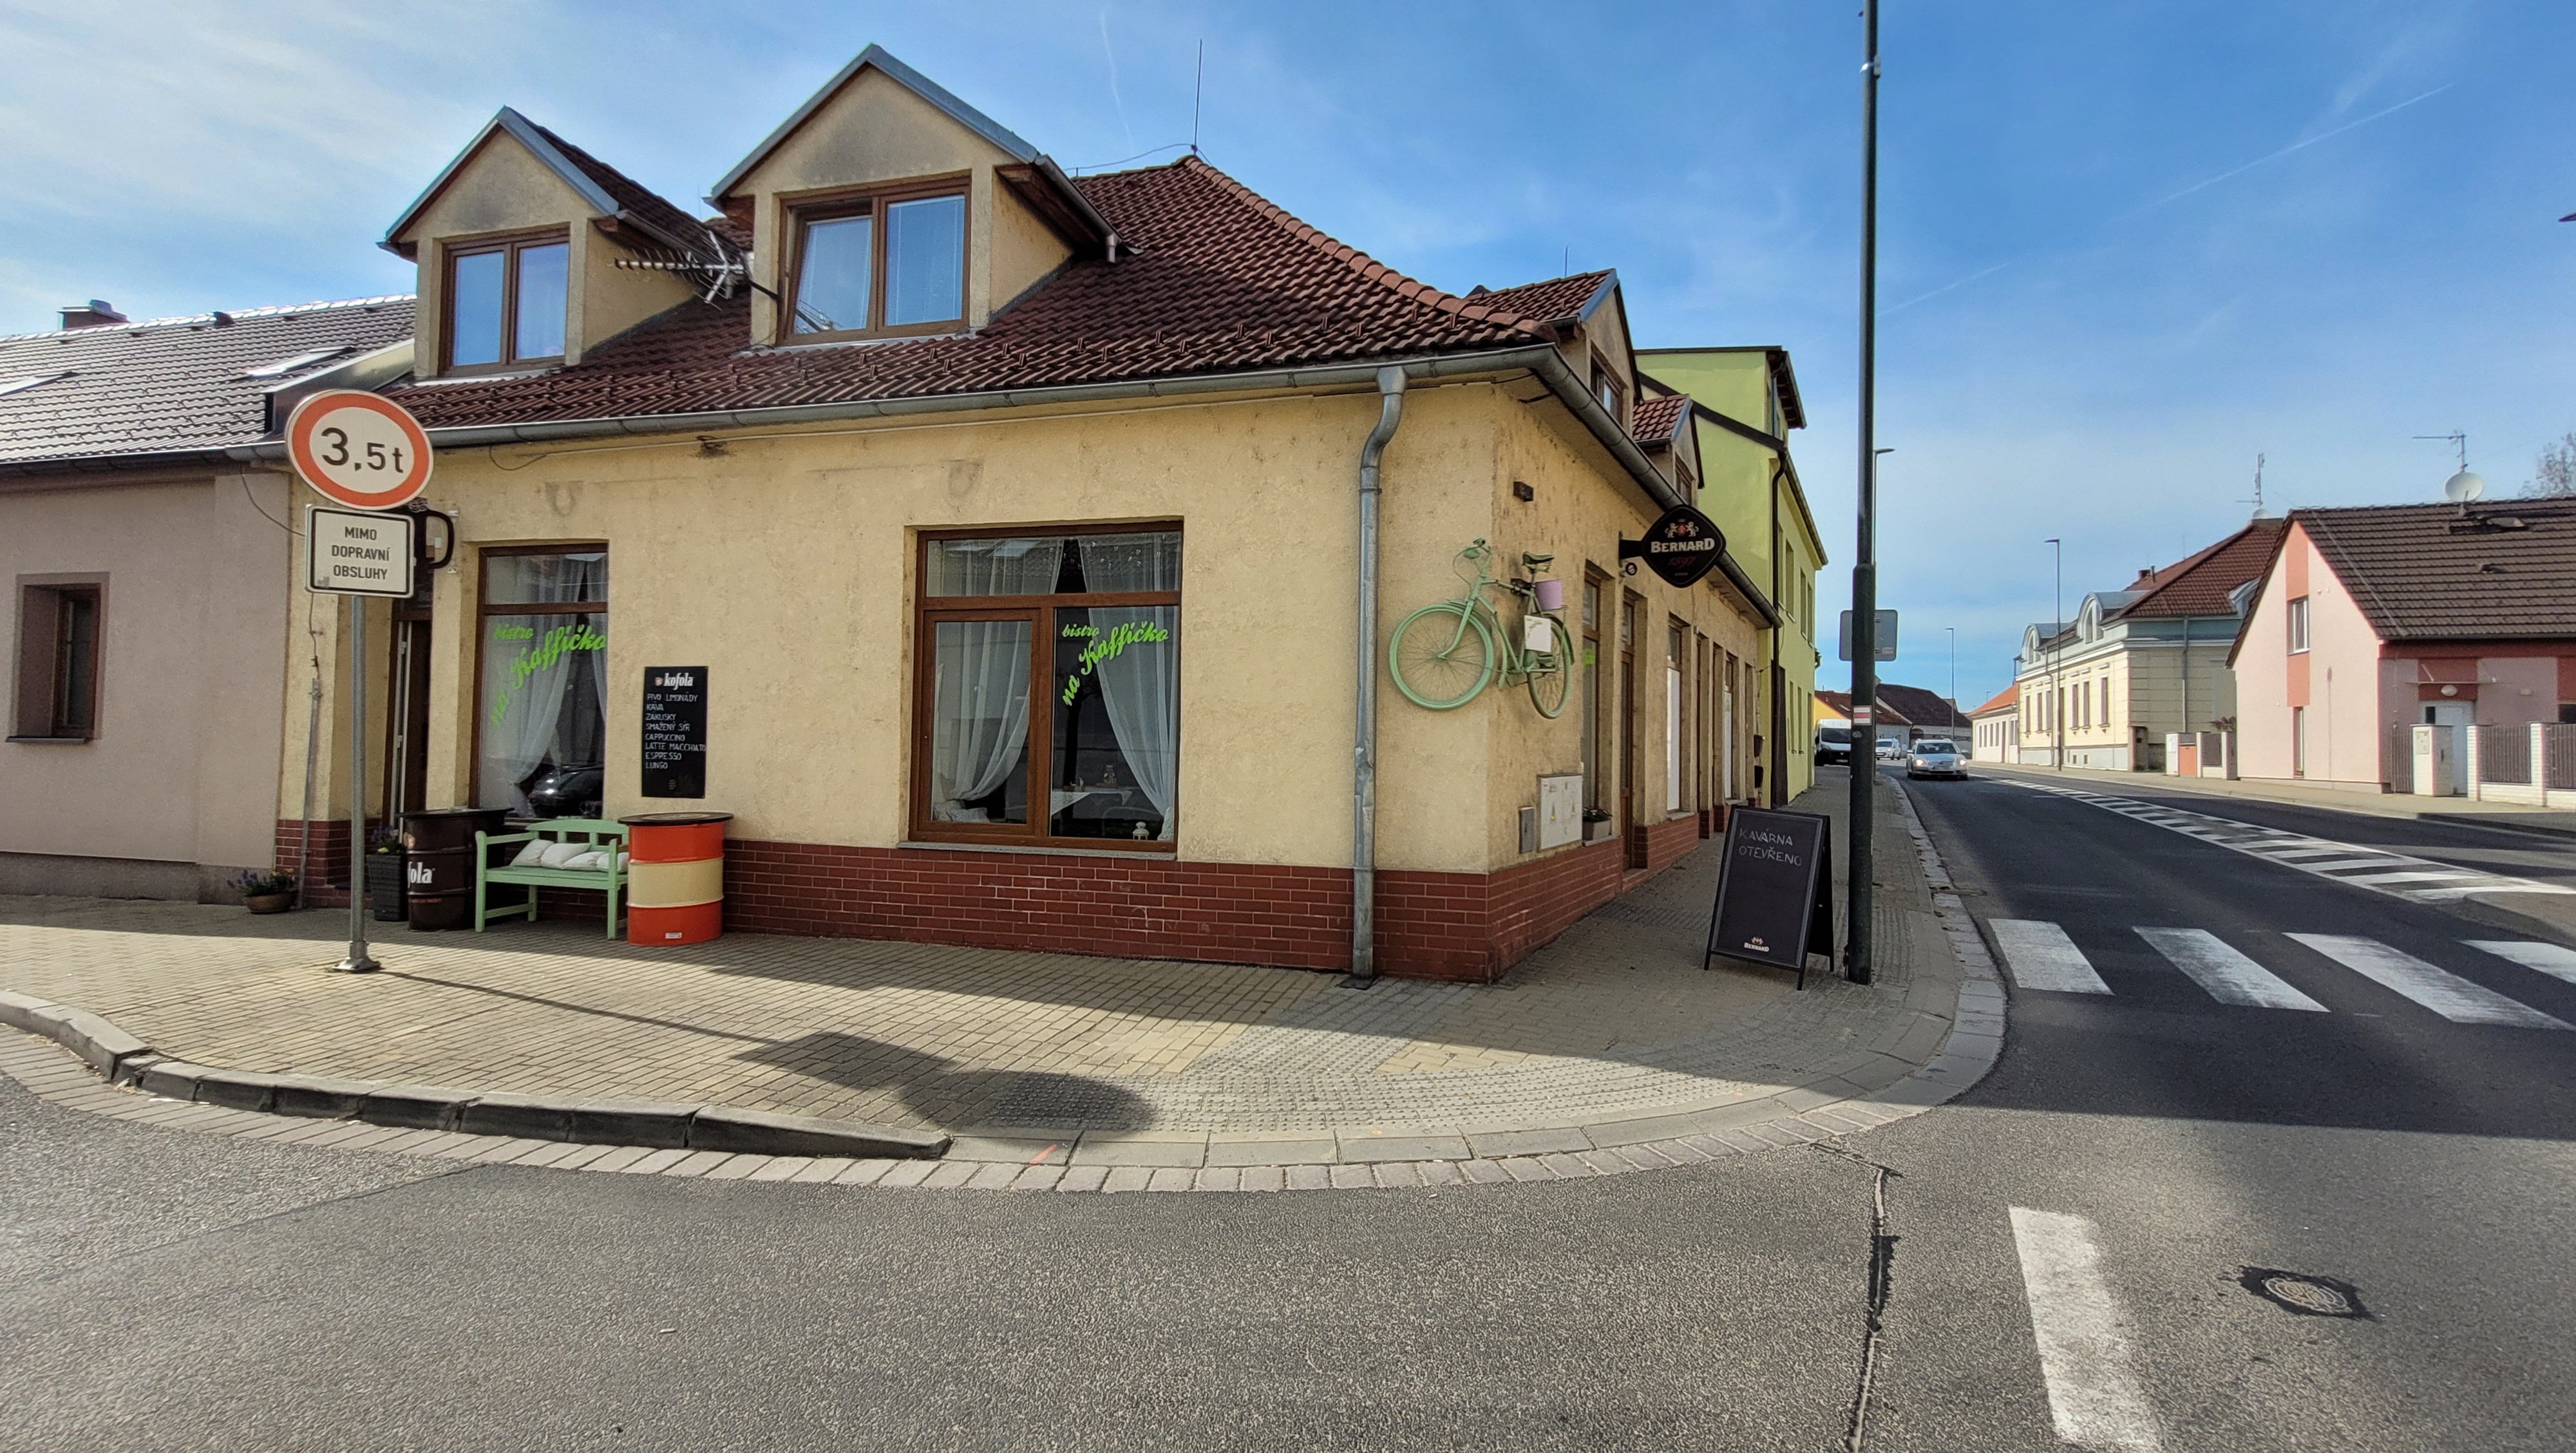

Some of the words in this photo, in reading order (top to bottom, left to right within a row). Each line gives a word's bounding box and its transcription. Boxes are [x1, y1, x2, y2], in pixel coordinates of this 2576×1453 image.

[345, 526, 377, 540] MIMO
[1651, 538, 1715, 553] BERNARD
[331, 545, 390, 561] DOPRAVNÍ
[1669, 556, 1697, 569] 1597
[333, 564, 388, 580] OBSLUHY
[493, 622, 535, 640] bistro
[1061, 623, 1100, 638] bistro
[663, 672, 694, 691] kofola
[647, 693, 662, 701] PIVO
[665, 691, 699, 703] LIMONÁDY
[1062, 674, 1080, 707] na
[491, 689, 509, 728] na
[646, 701, 665, 712] KÁVA
[645, 711, 677, 721] ZÁKUSKY
[646, 721, 676, 732] SMAŽENÝ
[678, 721, 691, 732] SÝR
[645, 733, 686, 742] CAPPUCCINO
[669, 743, 706, 752] MACCHIATO
[645, 752, 682, 761] ESPRESSO
[646, 761, 668, 770] LUNGO
[1739, 828, 1793, 846] KAVÁRNA
[1739, 845, 1803, 866] OTEVŘENO
